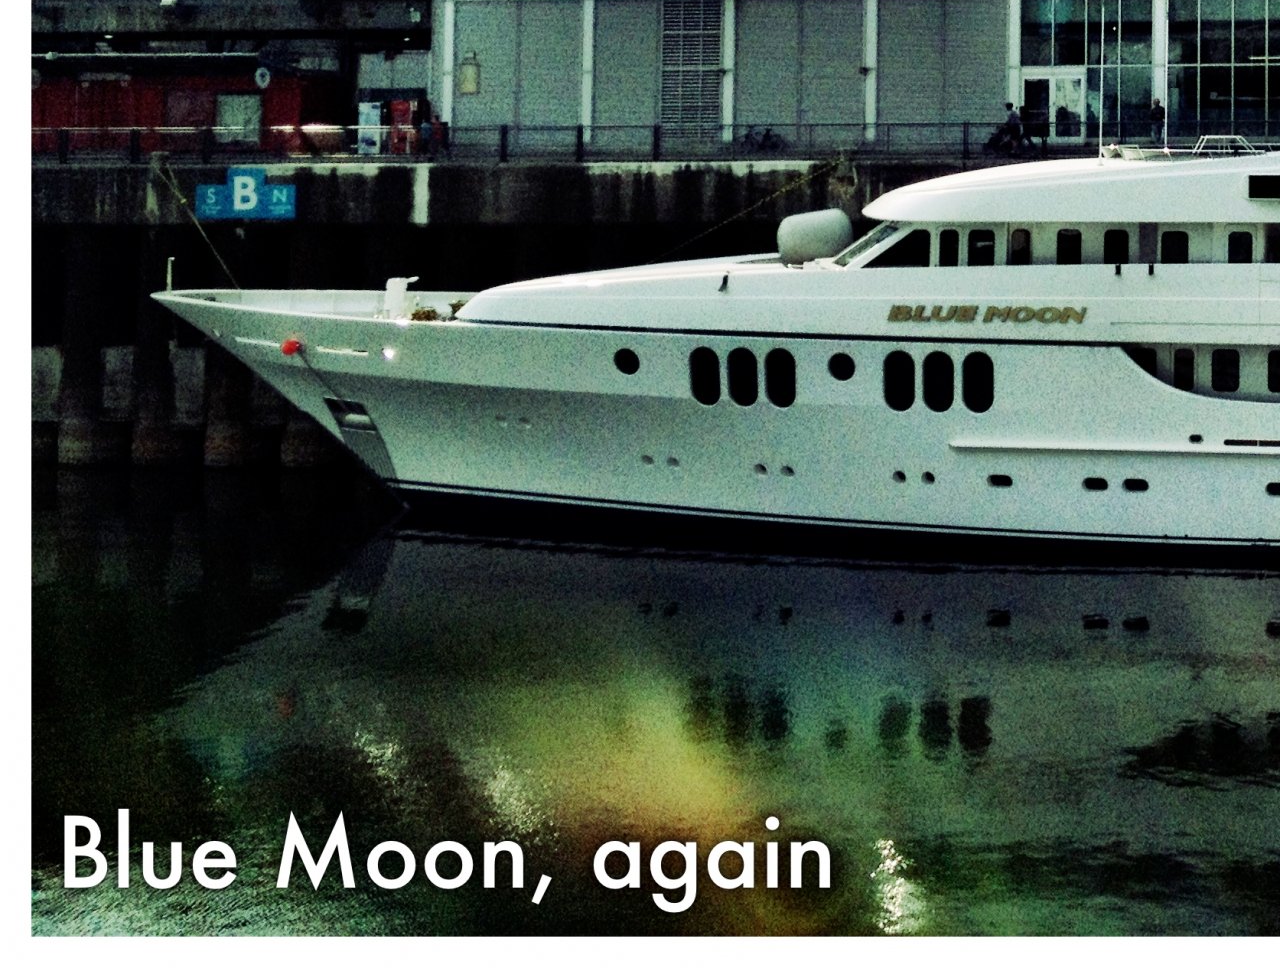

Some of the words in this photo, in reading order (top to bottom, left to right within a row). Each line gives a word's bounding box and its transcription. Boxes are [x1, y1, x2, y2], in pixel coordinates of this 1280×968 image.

[207, 188, 216, 204] S
[233, 175, 258, 211] B
[272, 189, 287, 203] N
[887, 304, 979, 323] BLUE
[982, 305, 1087, 324] MOON
